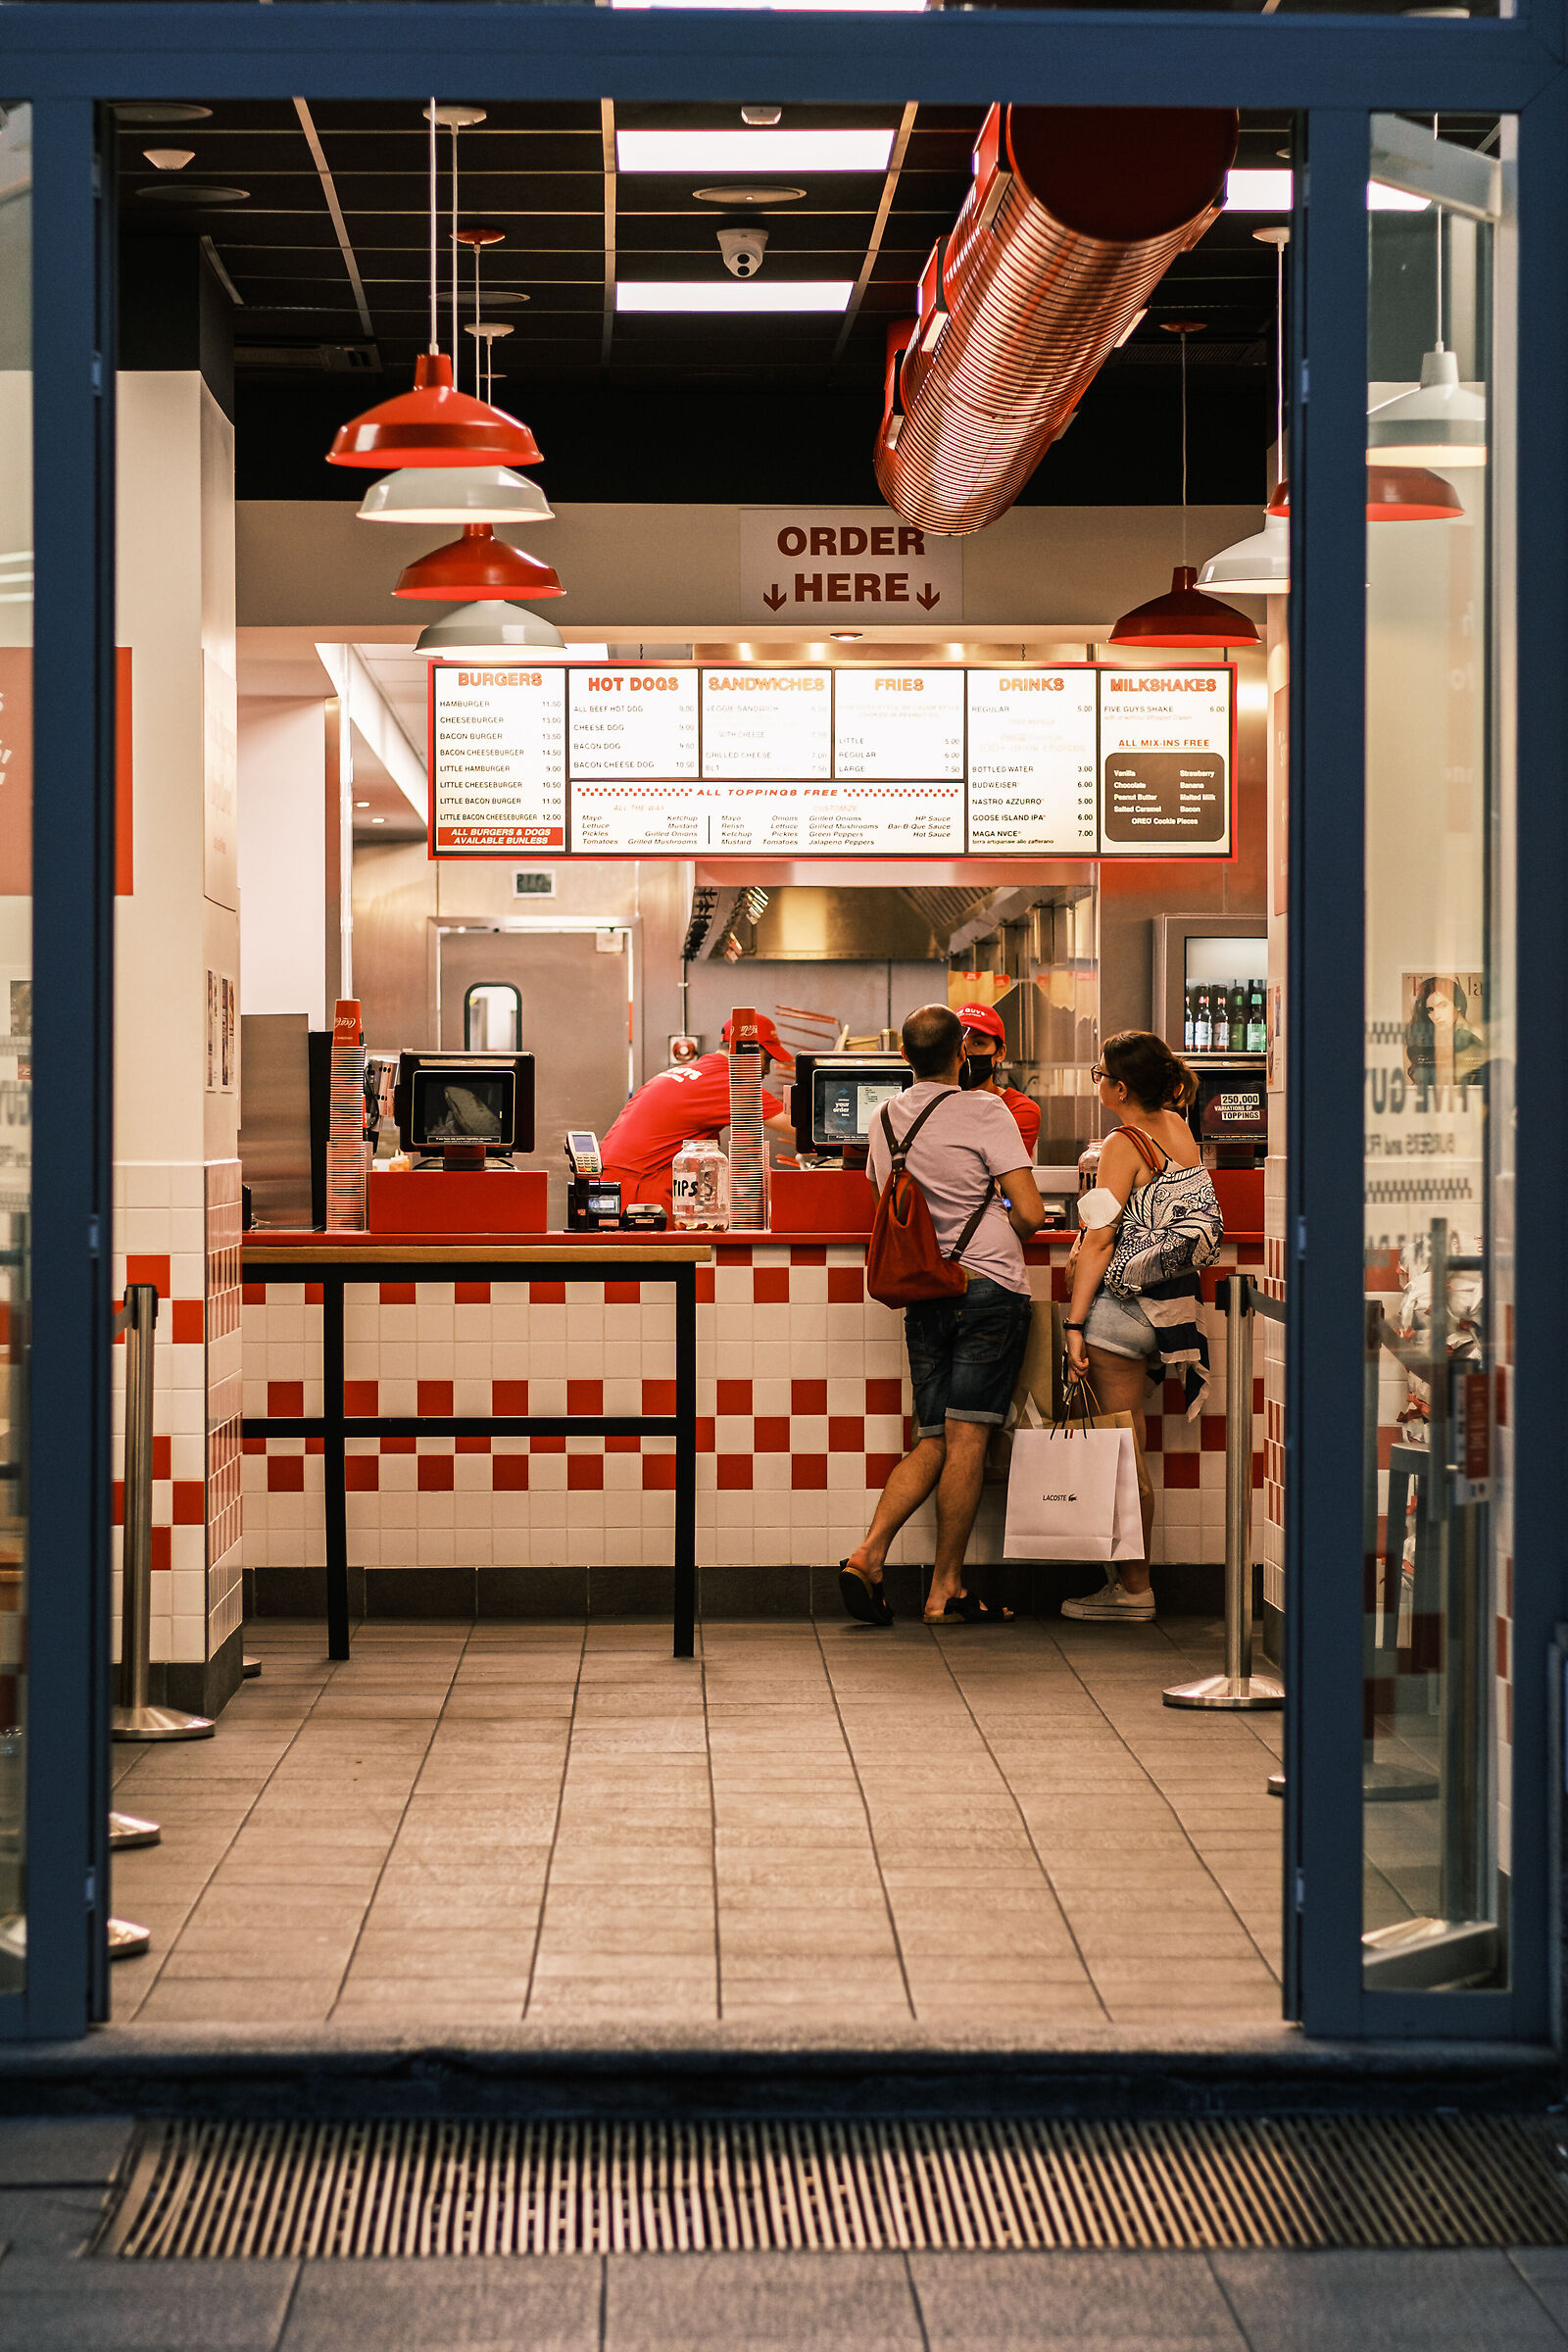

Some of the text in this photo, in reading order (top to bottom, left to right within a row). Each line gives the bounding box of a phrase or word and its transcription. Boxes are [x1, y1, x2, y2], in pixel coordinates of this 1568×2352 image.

[774, 525, 927, 558] ORDER
[792, 571, 912, 604] HERE
[458, 672, 543, 687] BURGERS
[588, 677, 679, 691] HOT DOGS
[708, 676, 825, 691] SANDWICHES
[874, 678, 924, 691] FRIES
[999, 677, 1065, 691] DRINKS
[1110, 678, 1217, 692] MILKSHAKES
[1183, 739, 1210, 747] FREE
[470, 828, 515, 836] BURGERS
[525, 828, 551, 836] DOGS
[505, 836, 548, 844] BUNLESS
[1222, 1095, 1258, 1104] 250,000
[674, 1179, 698, 1197] TIPS
